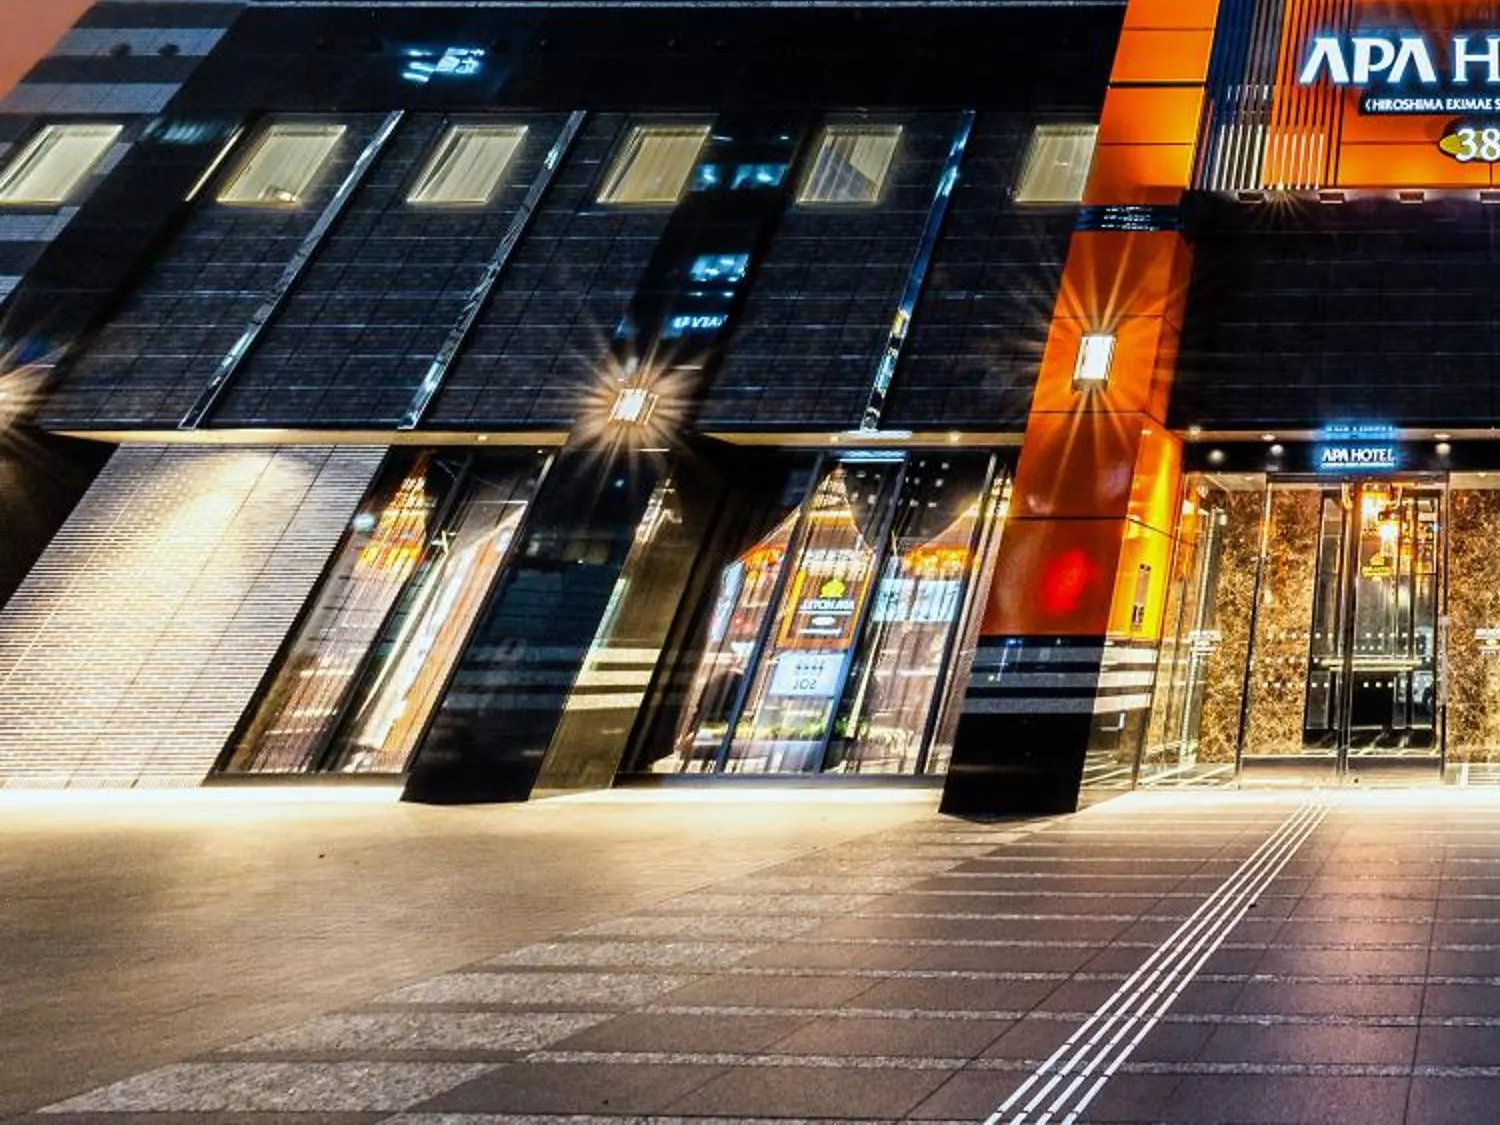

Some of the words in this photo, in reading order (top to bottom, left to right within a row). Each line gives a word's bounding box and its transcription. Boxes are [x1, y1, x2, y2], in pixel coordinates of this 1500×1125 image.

[1300, 36, 1437, 84] APA
[1446, 98, 1493, 110] EKIMAE
[1322, 448, 1349, 462] APA
[1351, 448, 1396, 462] HOTEL
